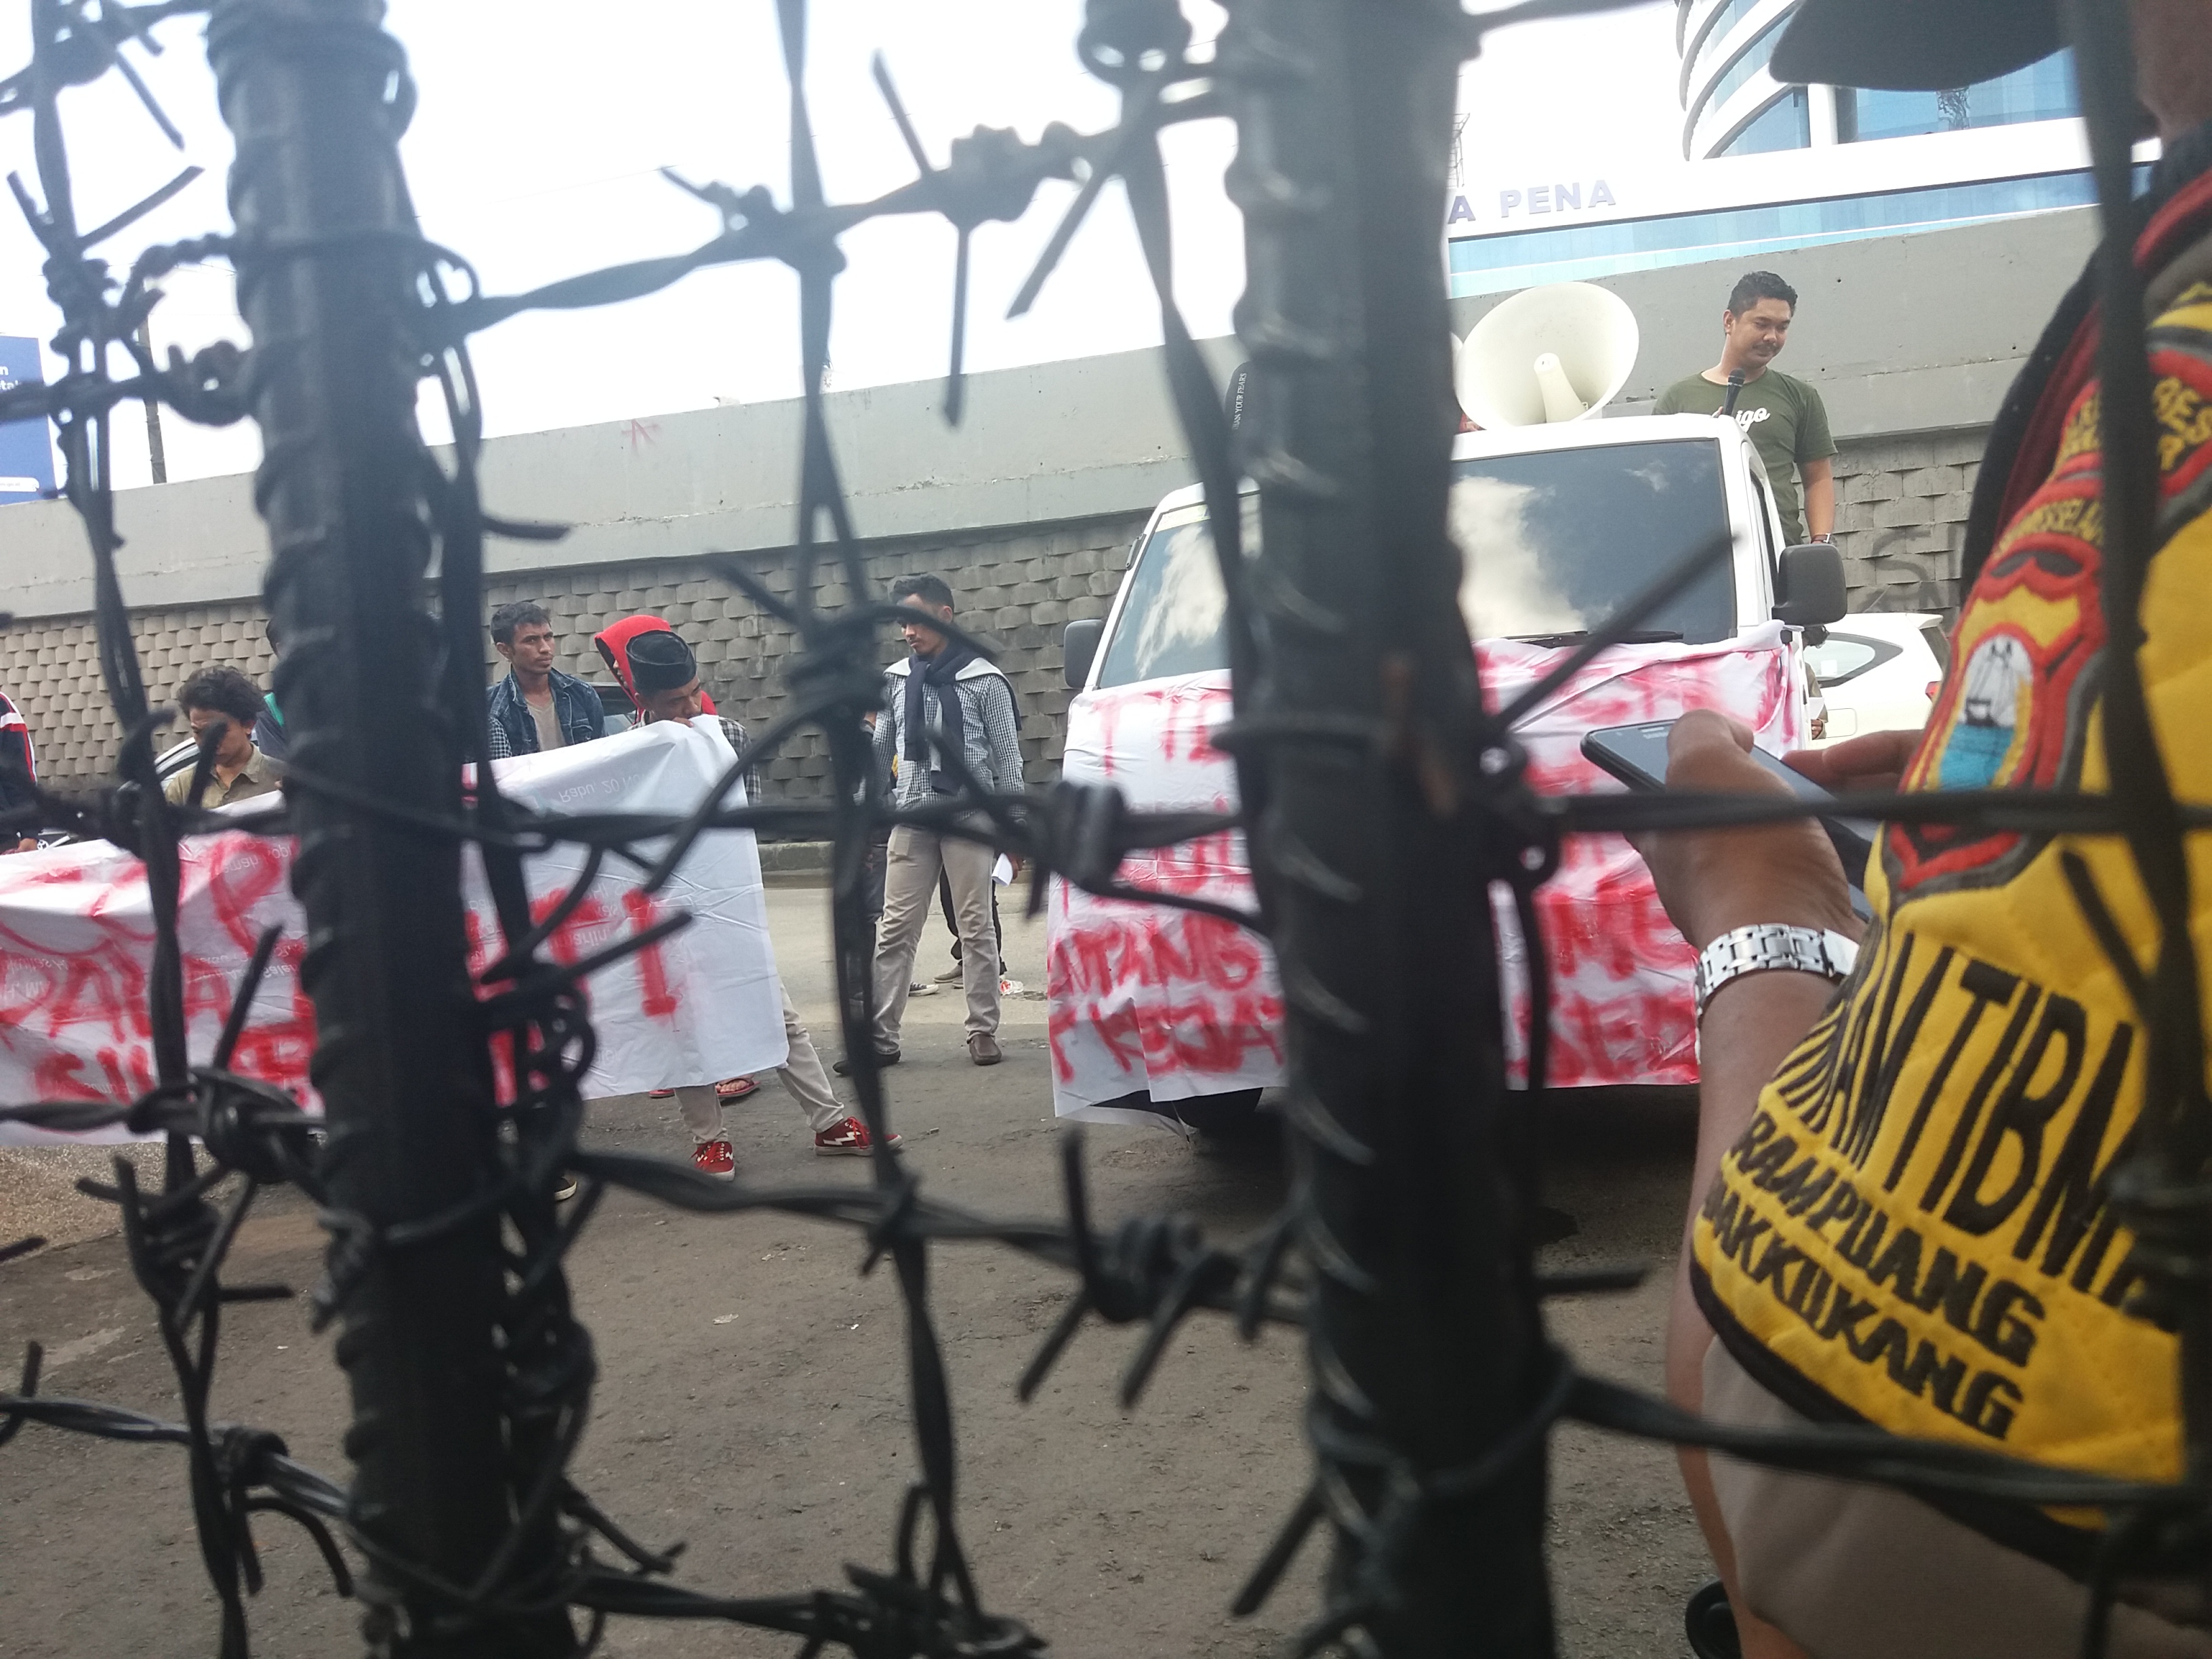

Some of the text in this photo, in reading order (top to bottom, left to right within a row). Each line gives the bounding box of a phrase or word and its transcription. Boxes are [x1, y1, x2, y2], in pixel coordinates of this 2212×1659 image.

[1500, 180, 1616, 218] PENA
[1237, 373, 1247, 394] FEARS
[1235, 394, 1244, 413] YOUR
